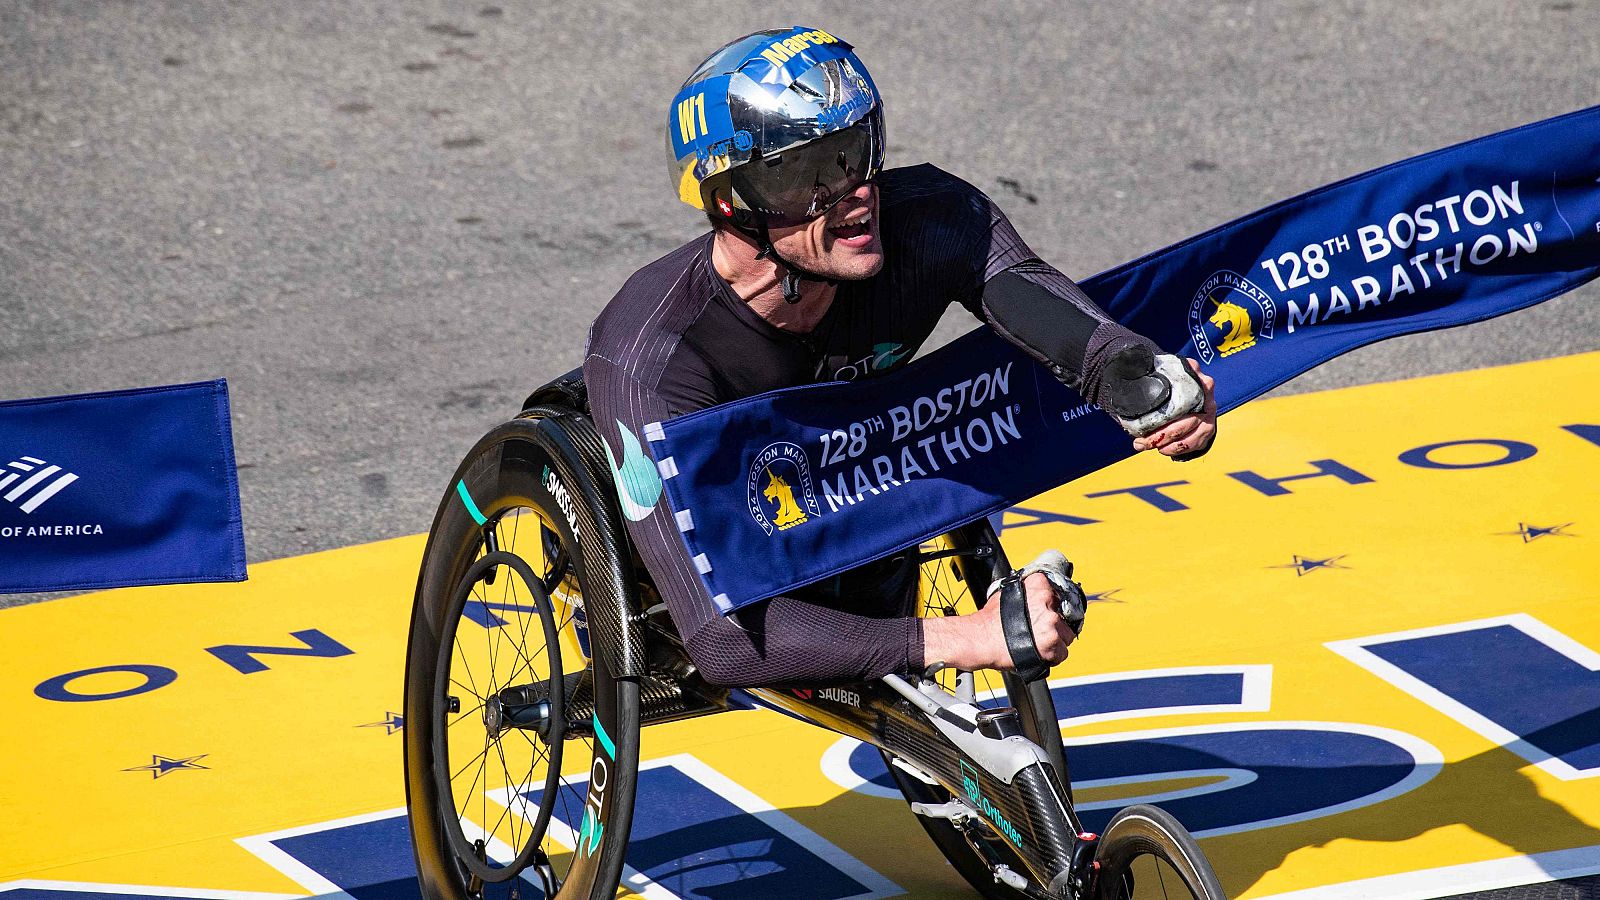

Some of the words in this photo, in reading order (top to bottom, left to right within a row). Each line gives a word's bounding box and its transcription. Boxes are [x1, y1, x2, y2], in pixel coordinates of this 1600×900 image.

[760, 29, 839, 68] Marcel
[677, 92, 709, 145] W1
[1261, 234, 1350, 293] 128TH
[1356, 180, 1524, 263] BOSTON
[1191, 275, 1219, 319] BOSTON
[1224, 273, 1274, 329] MARATHON
[1192, 324, 1210, 358] 2024
[819, 416, 885, 468] 128TH
[888, 361, 1013, 443] BOSTON
[1062, 403, 1092, 422] BANK
[750, 447, 778, 491] BOSTON
[784, 445, 816, 508] MARATHON
[1, 526, 22, 537] OF
[26, 524, 104, 537] AMERICA
[750, 497, 769, 529] 2024
[818, 687, 860, 708] SAUBER
[983, 797, 1022, 848] Orthotec
